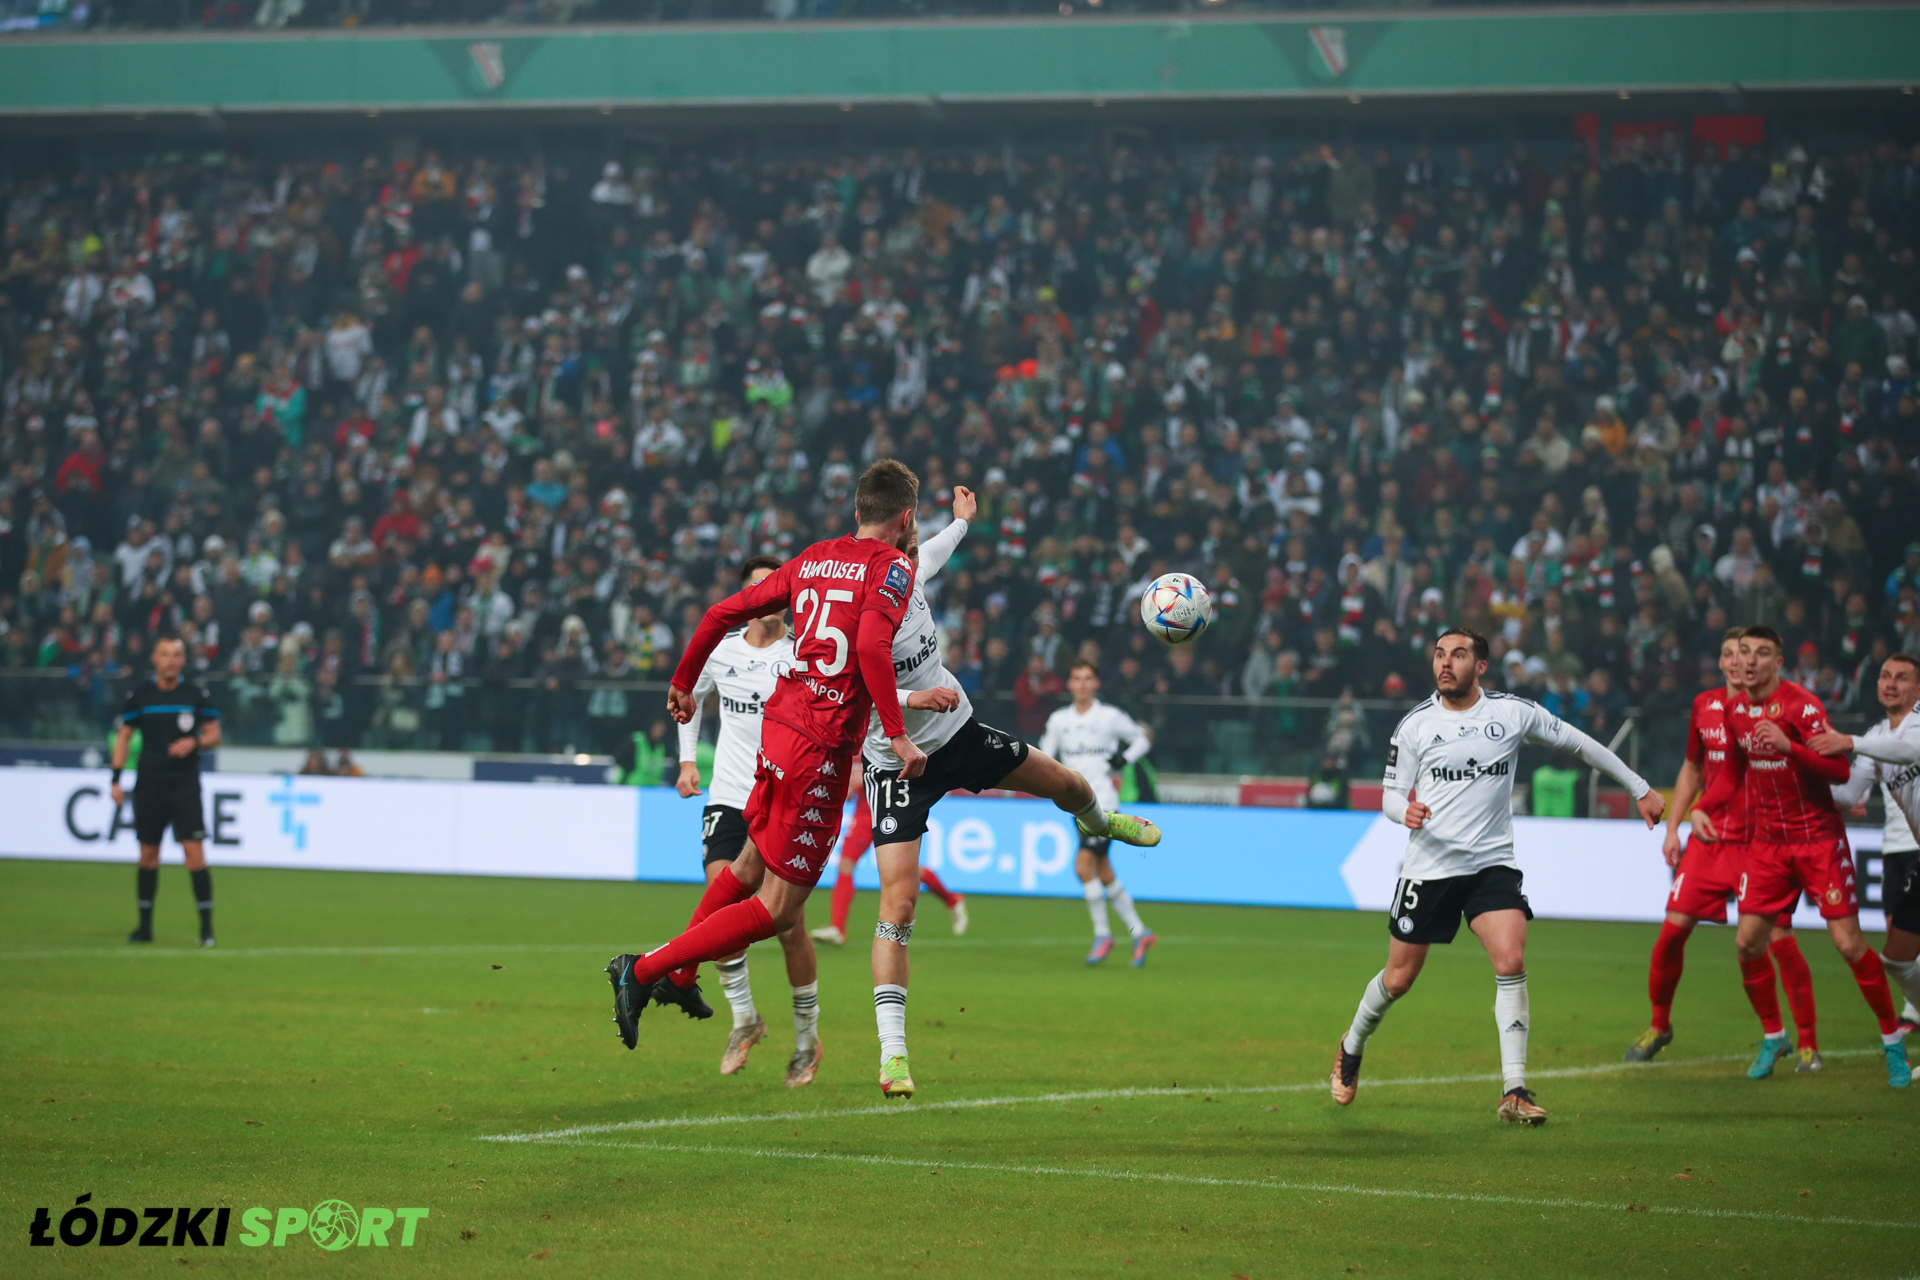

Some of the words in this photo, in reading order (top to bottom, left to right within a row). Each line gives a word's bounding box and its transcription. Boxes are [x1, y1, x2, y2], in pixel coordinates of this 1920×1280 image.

[795, 588, 854, 677] 25
[881, 777, 910, 809] 13
[1404, 879, 1423, 910] 5
